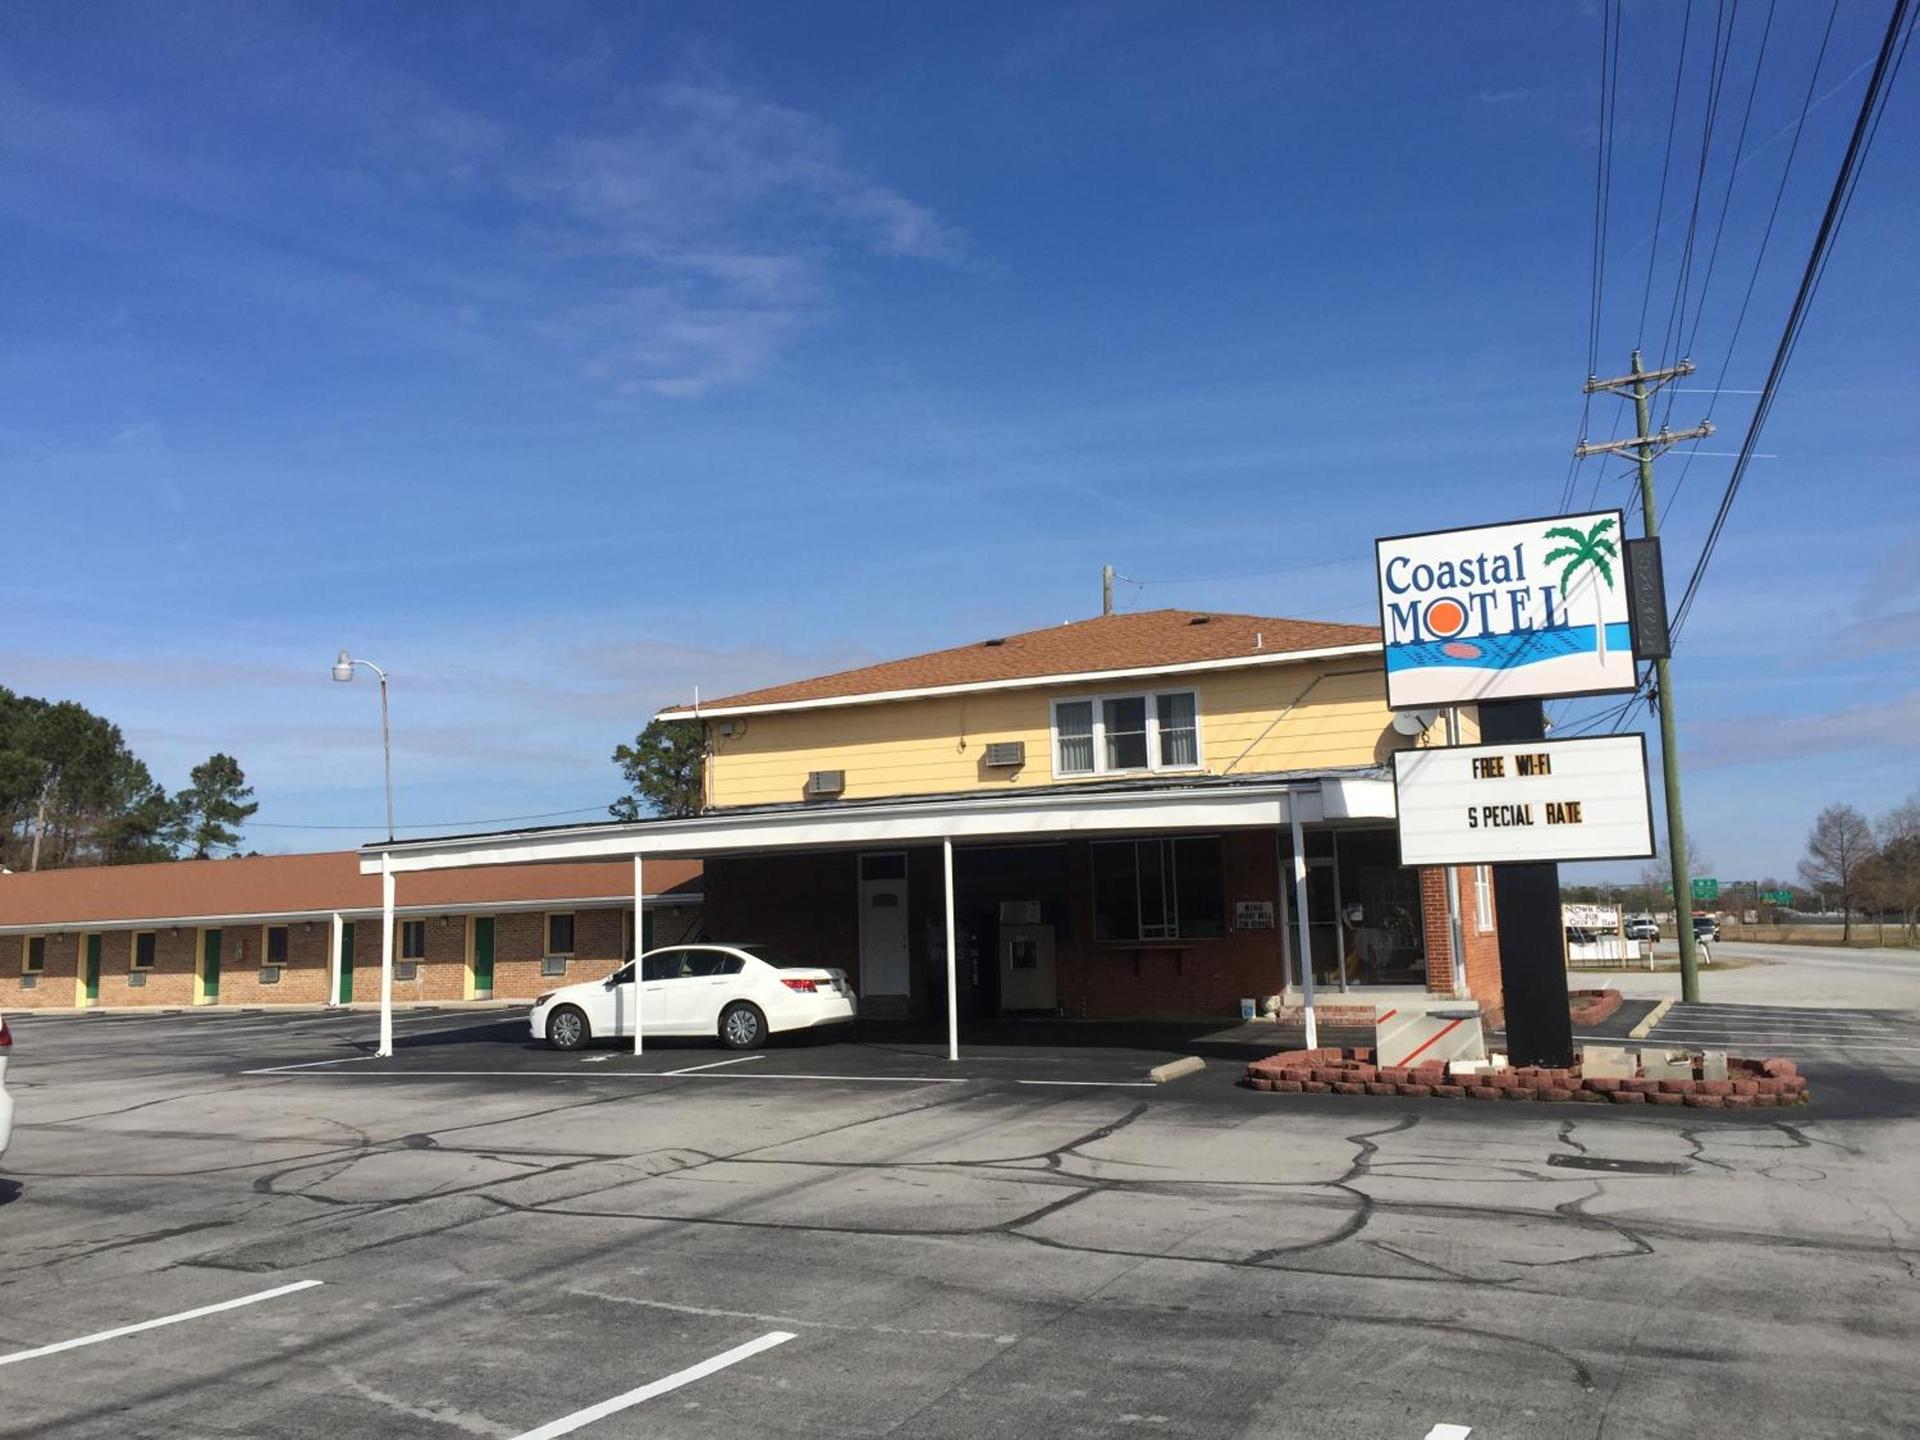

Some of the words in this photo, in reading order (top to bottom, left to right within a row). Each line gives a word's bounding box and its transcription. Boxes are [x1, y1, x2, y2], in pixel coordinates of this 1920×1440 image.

[1385, 542, 1527, 595] Coastal
[1387, 585, 1570, 648] MOTEL
[1472, 756, 1505, 779] FREE
[1515, 753, 1552, 777] WI-FI
[1546, 801, 1582, 825] RATE
